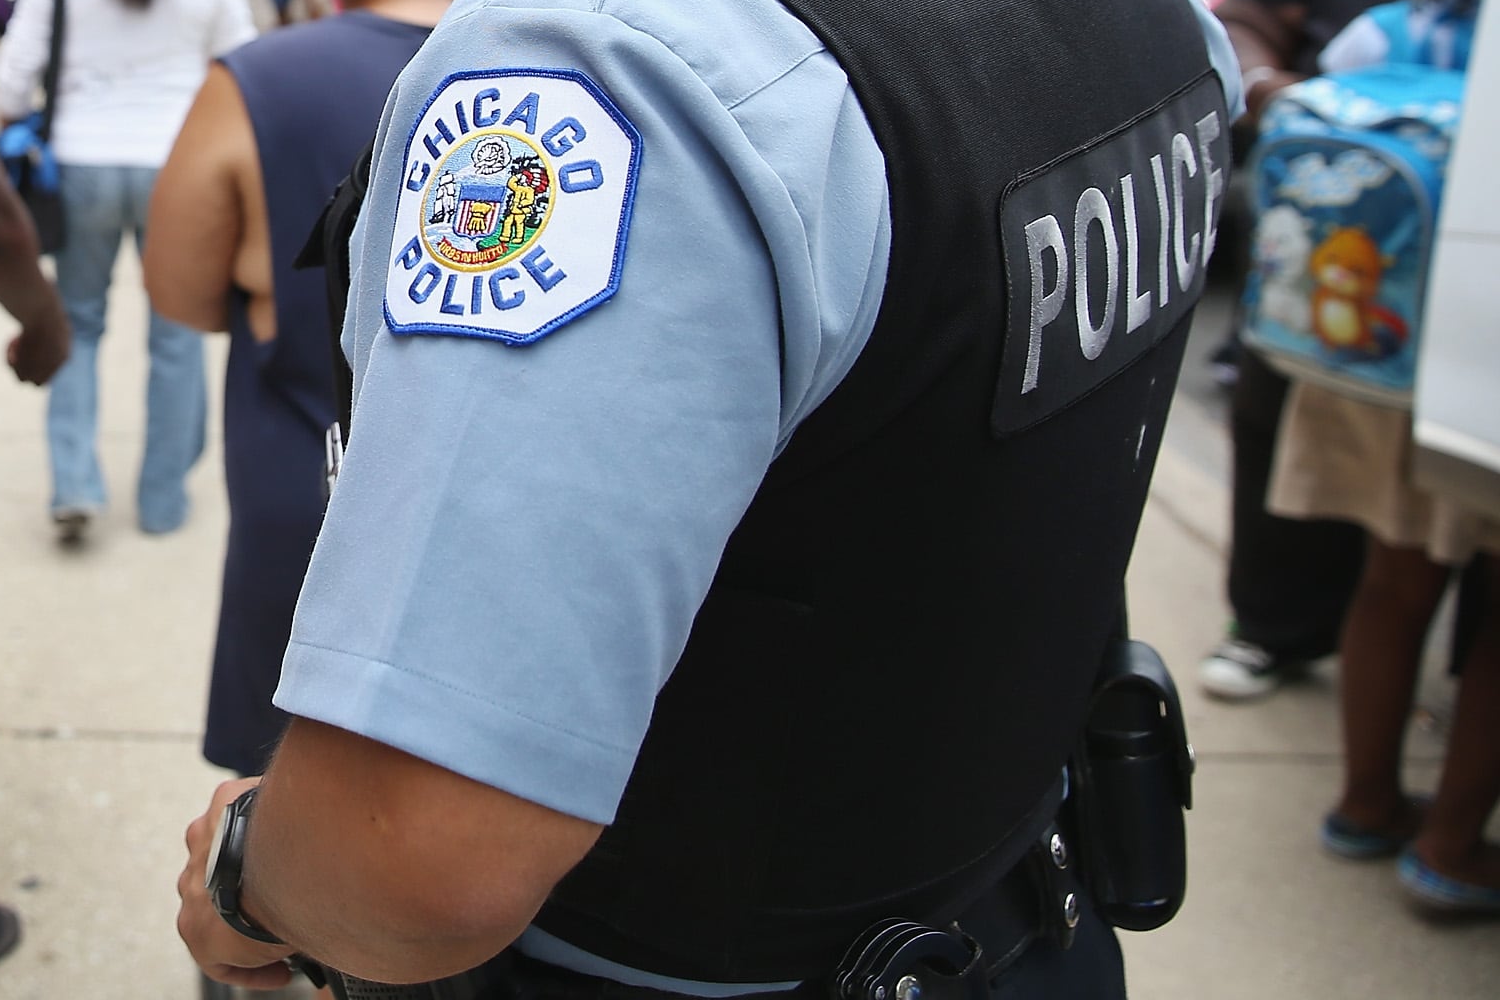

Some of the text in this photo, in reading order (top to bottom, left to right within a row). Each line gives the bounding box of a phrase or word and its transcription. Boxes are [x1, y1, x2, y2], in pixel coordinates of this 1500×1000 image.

[406, 87, 604, 193] CHICAGO
[394, 235, 567, 316] POLICE
[1020, 110, 1223, 395] POLICE
